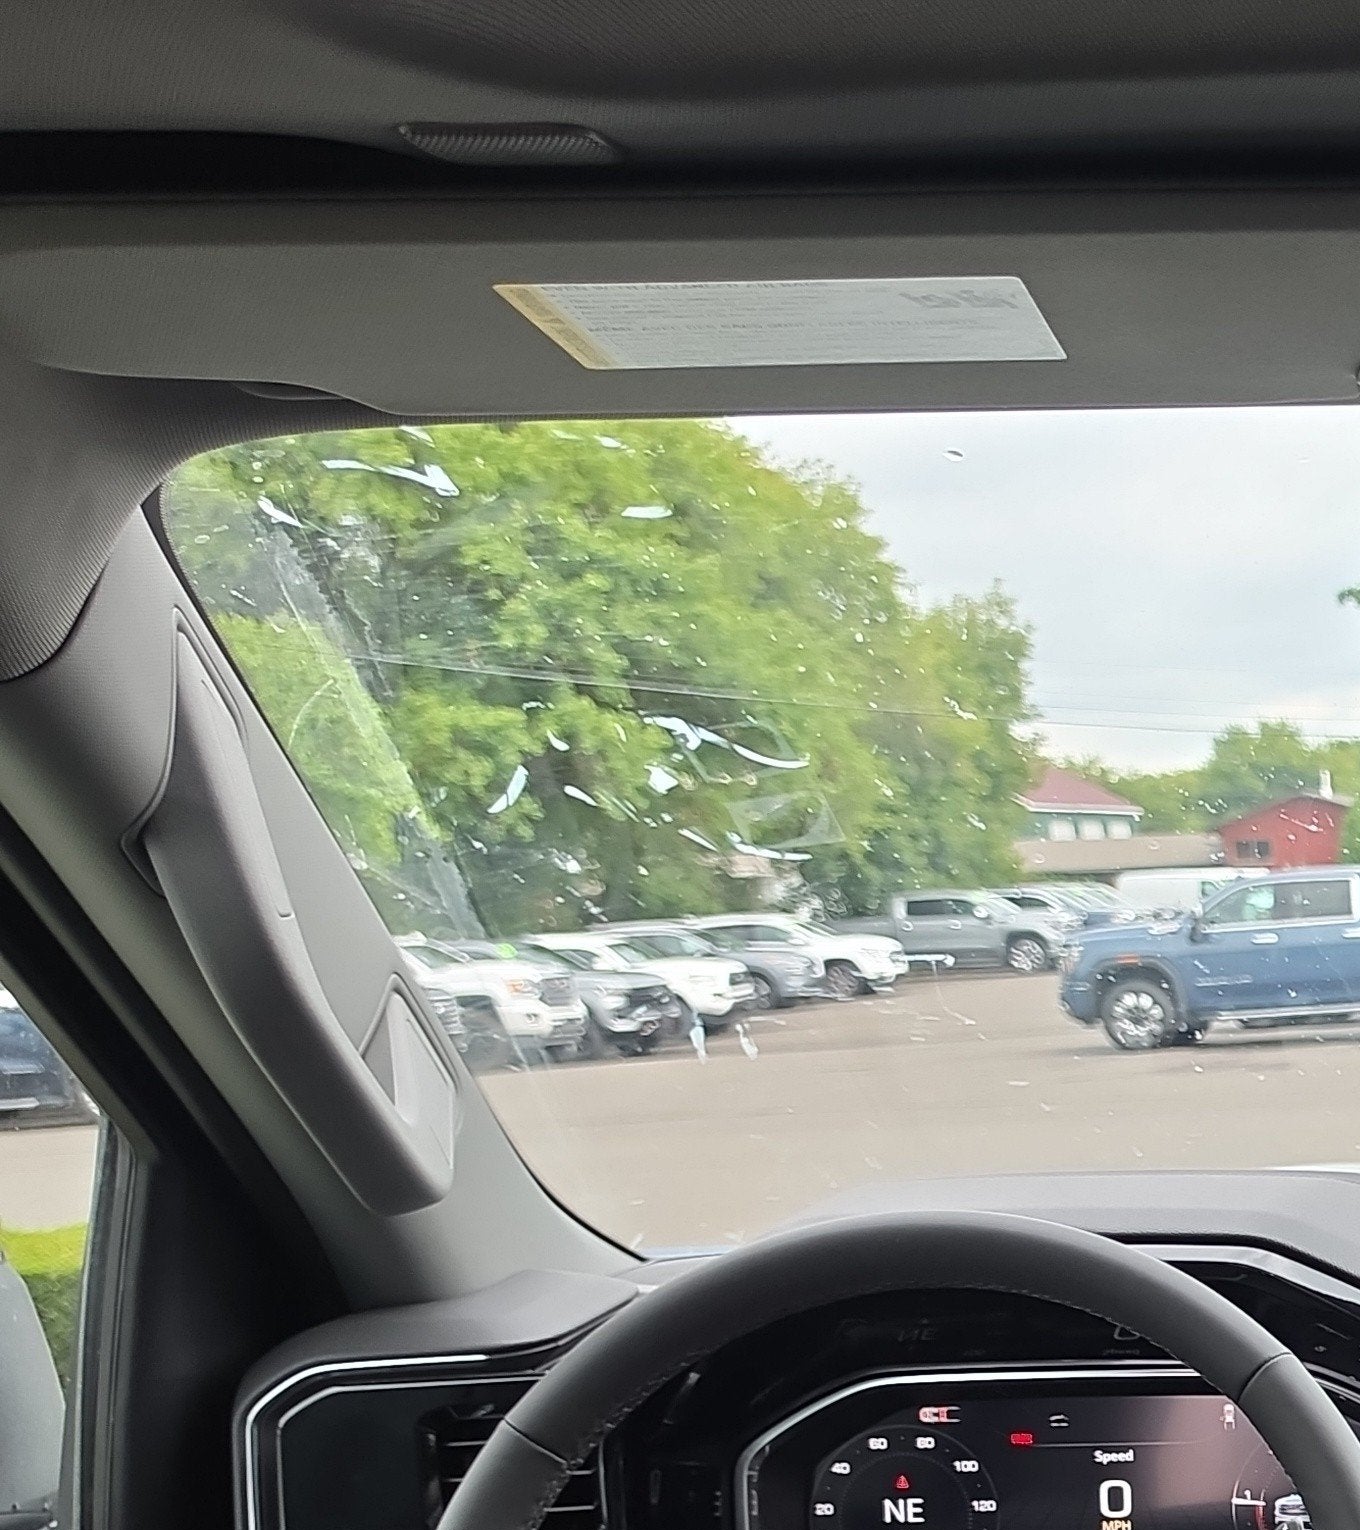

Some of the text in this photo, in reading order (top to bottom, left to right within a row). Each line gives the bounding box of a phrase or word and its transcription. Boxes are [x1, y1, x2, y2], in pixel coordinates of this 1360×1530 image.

[1093, 1449, 1134, 1465] Speed
[830, 1462, 851, 1475] 40
[953, 1460, 979, 1472] 100
[1099, 1479, 1132, 1519] 0
[814, 1503, 834, 1515] 20
[883, 1498, 925, 1523] NE
[971, 1500, 997, 1512] 120
